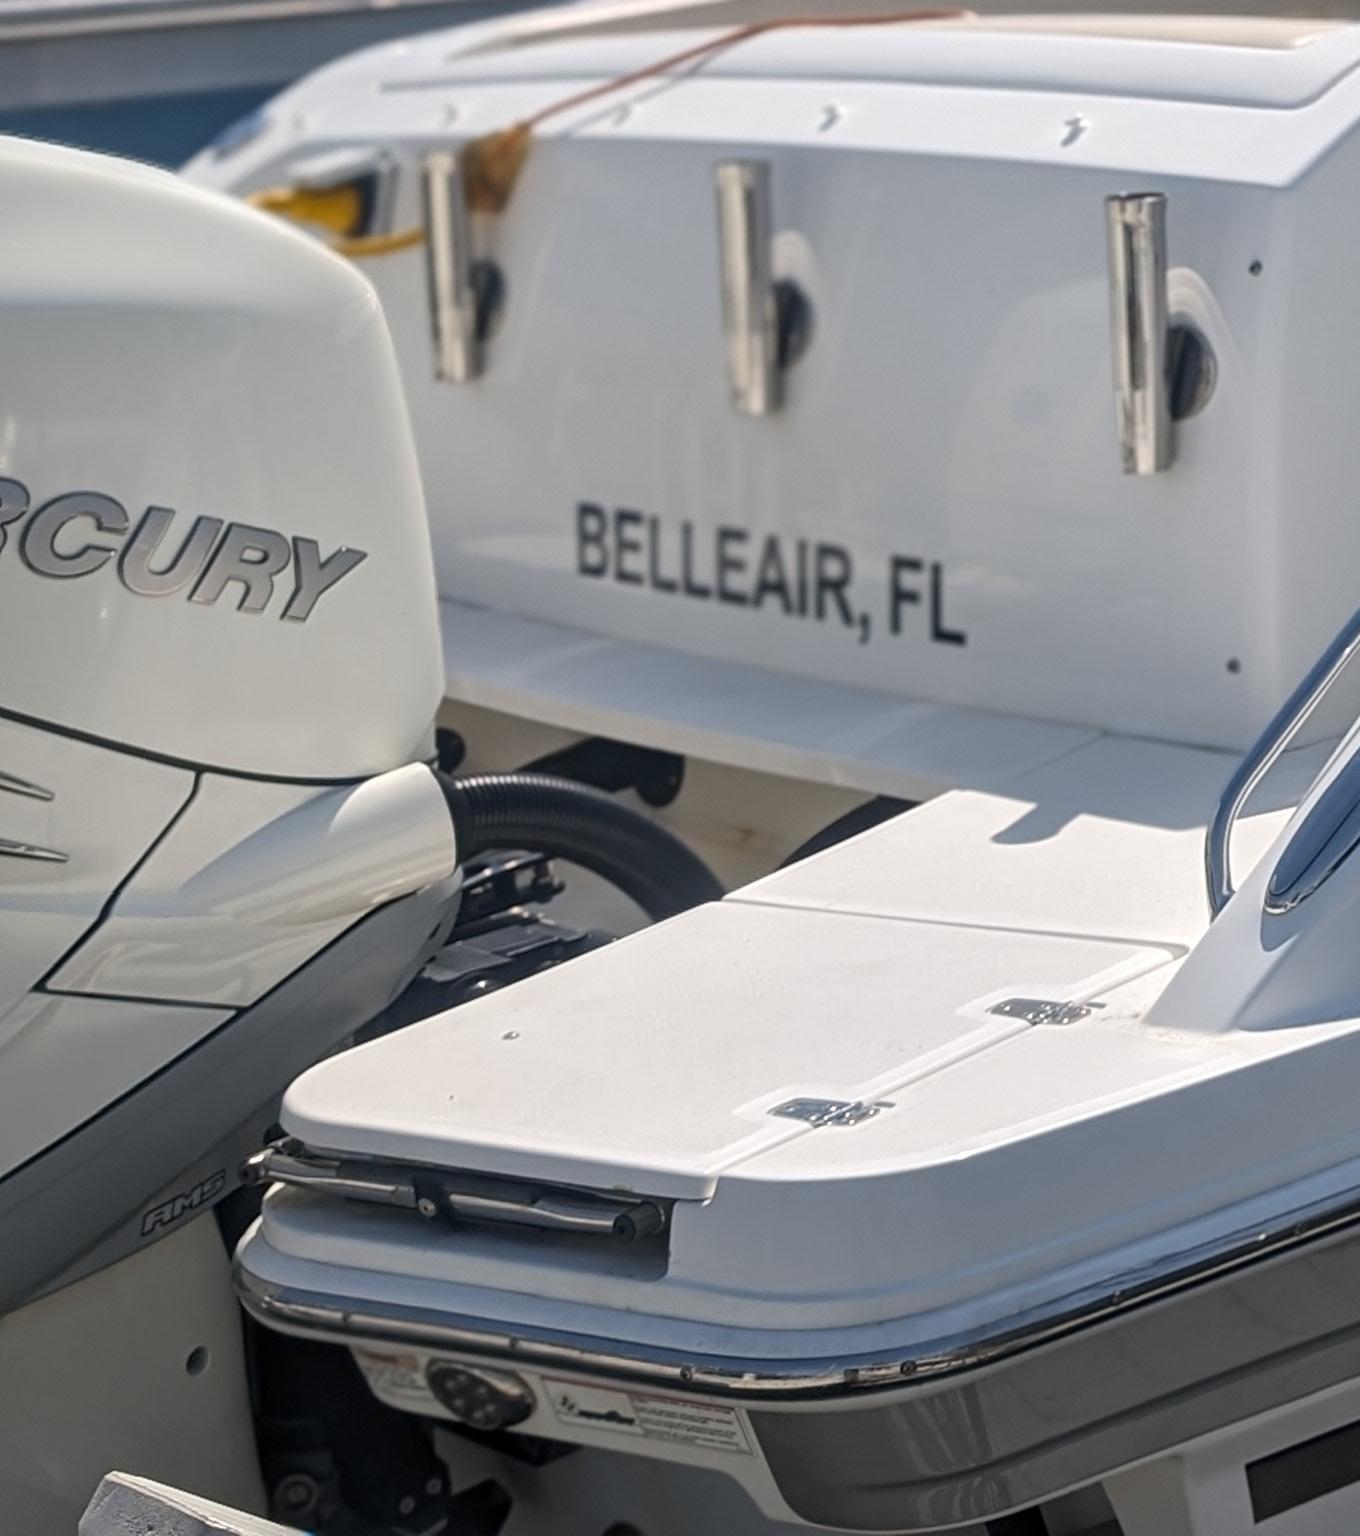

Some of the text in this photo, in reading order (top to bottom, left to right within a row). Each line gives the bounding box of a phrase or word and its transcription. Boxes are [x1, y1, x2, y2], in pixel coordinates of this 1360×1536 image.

[576, 501, 968, 647] BELLEAIR, FL
[141, 1168, 226, 1237] AMS
